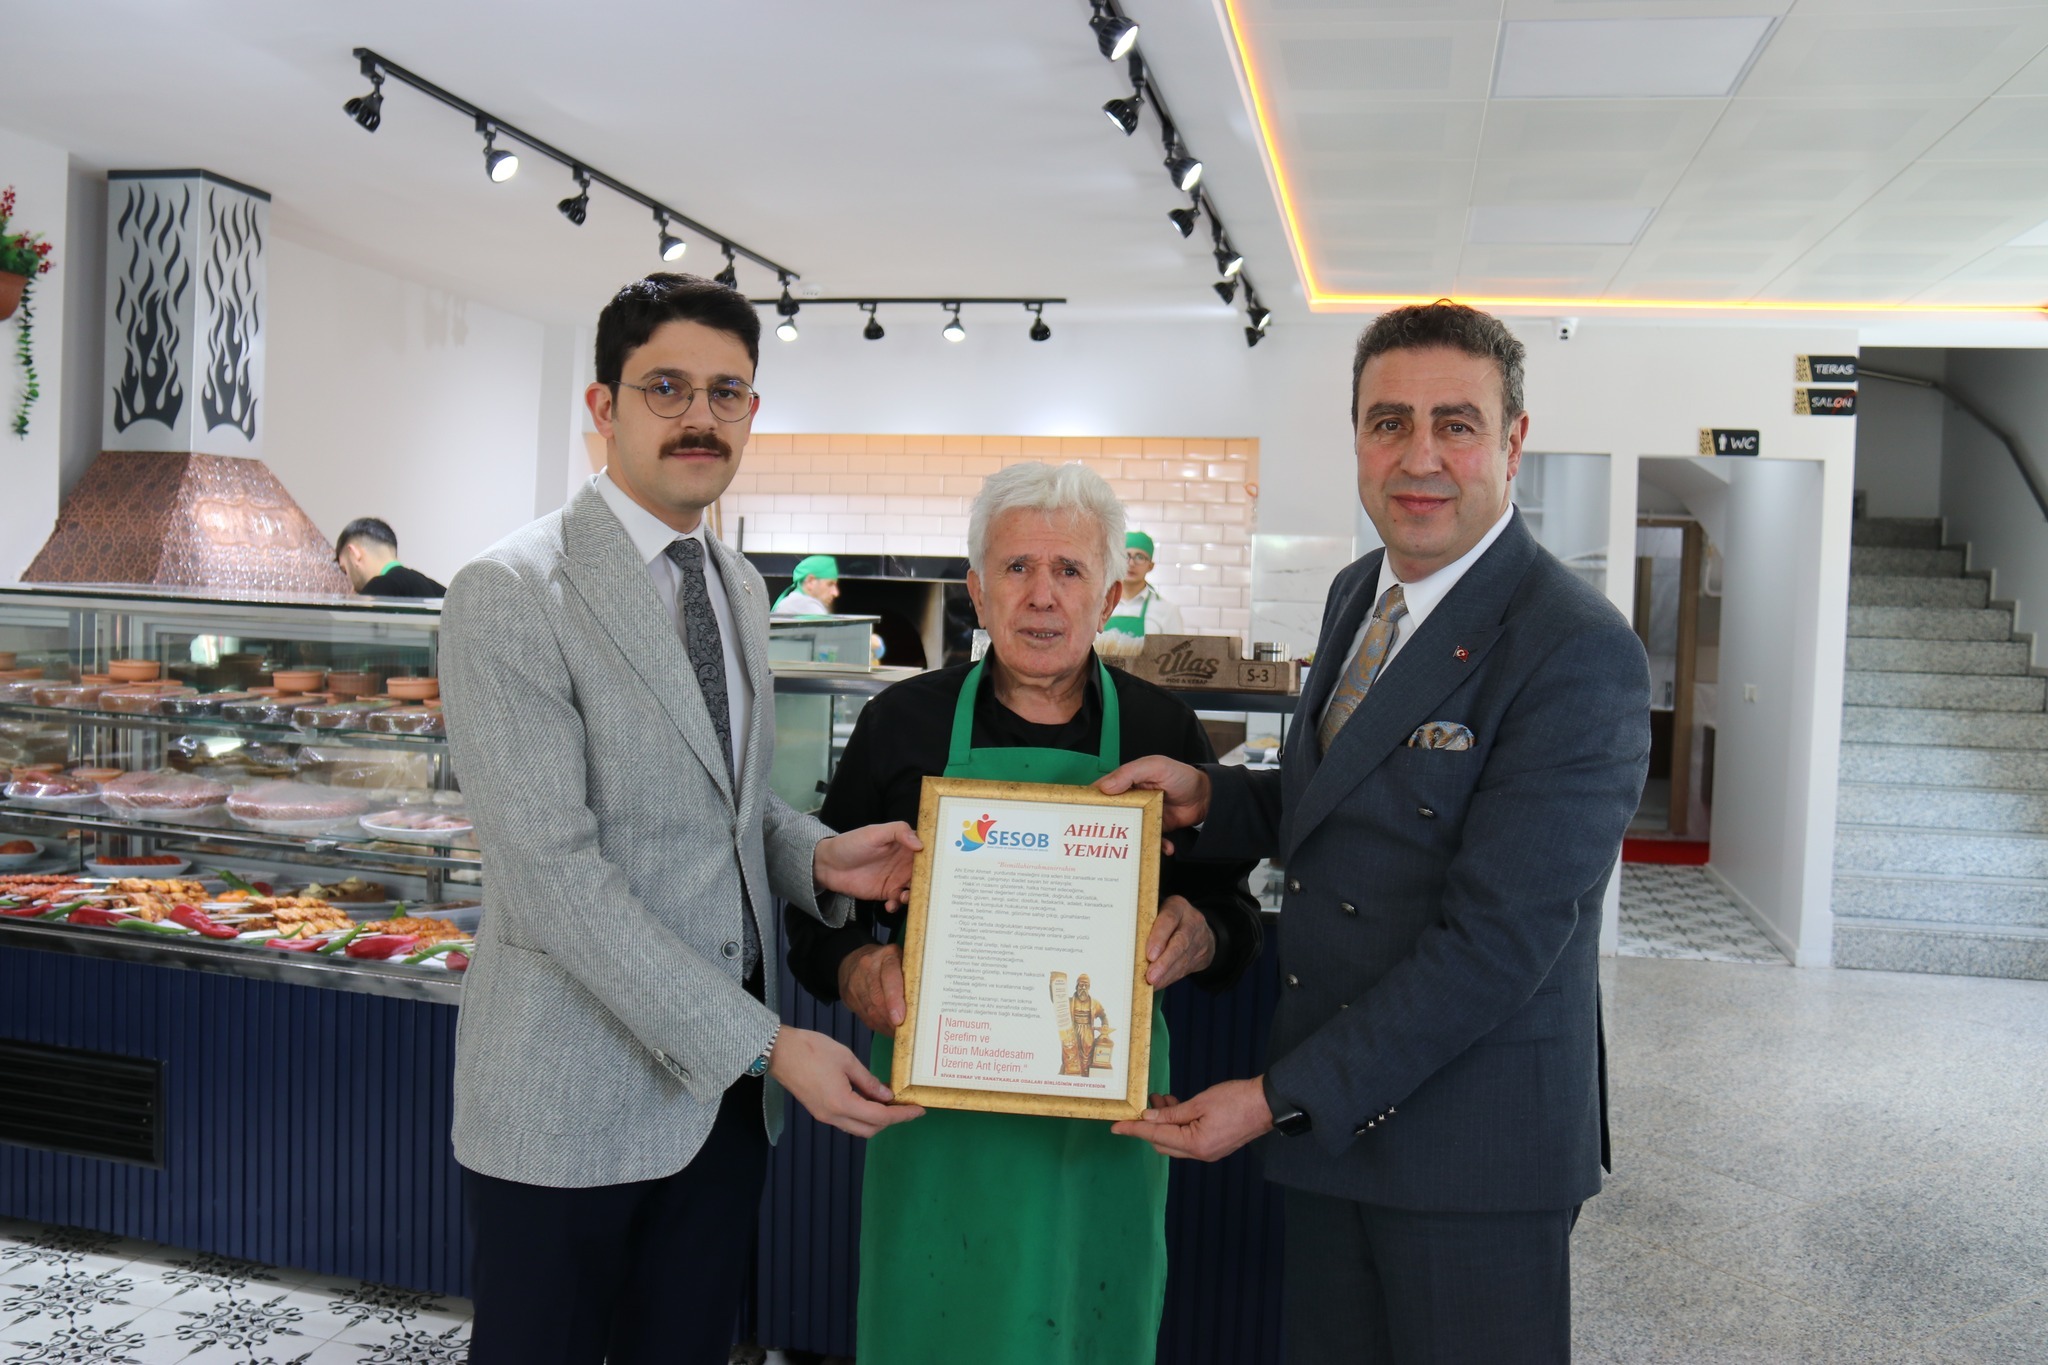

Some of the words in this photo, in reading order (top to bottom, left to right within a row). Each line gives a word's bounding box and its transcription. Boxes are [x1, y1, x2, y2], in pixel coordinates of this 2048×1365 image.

[1814, 363, 1855, 375] TERAS
[1811, 396, 1853, 408] SALON
[1730, 436, 1757, 450] WC
[1246, 668, 1269, 683] S-3
[1064, 822, 1128, 839] AHİLİK
[987, 830, 1048, 847] SESOB
[1064, 843, 1128, 859] YEMİNİ
[945, 1017, 991, 1030] Namusum,
[943, 1030, 977, 1042] Şerefim
[979, 1035, 989, 1043] ve
[942, 1044, 967, 1055] Bütün
[970, 1046, 1034, 1059] Mukaddesatım
[941, 1056, 973, 1069] Üzerine
[975, 1060, 991, 1070] Ant
